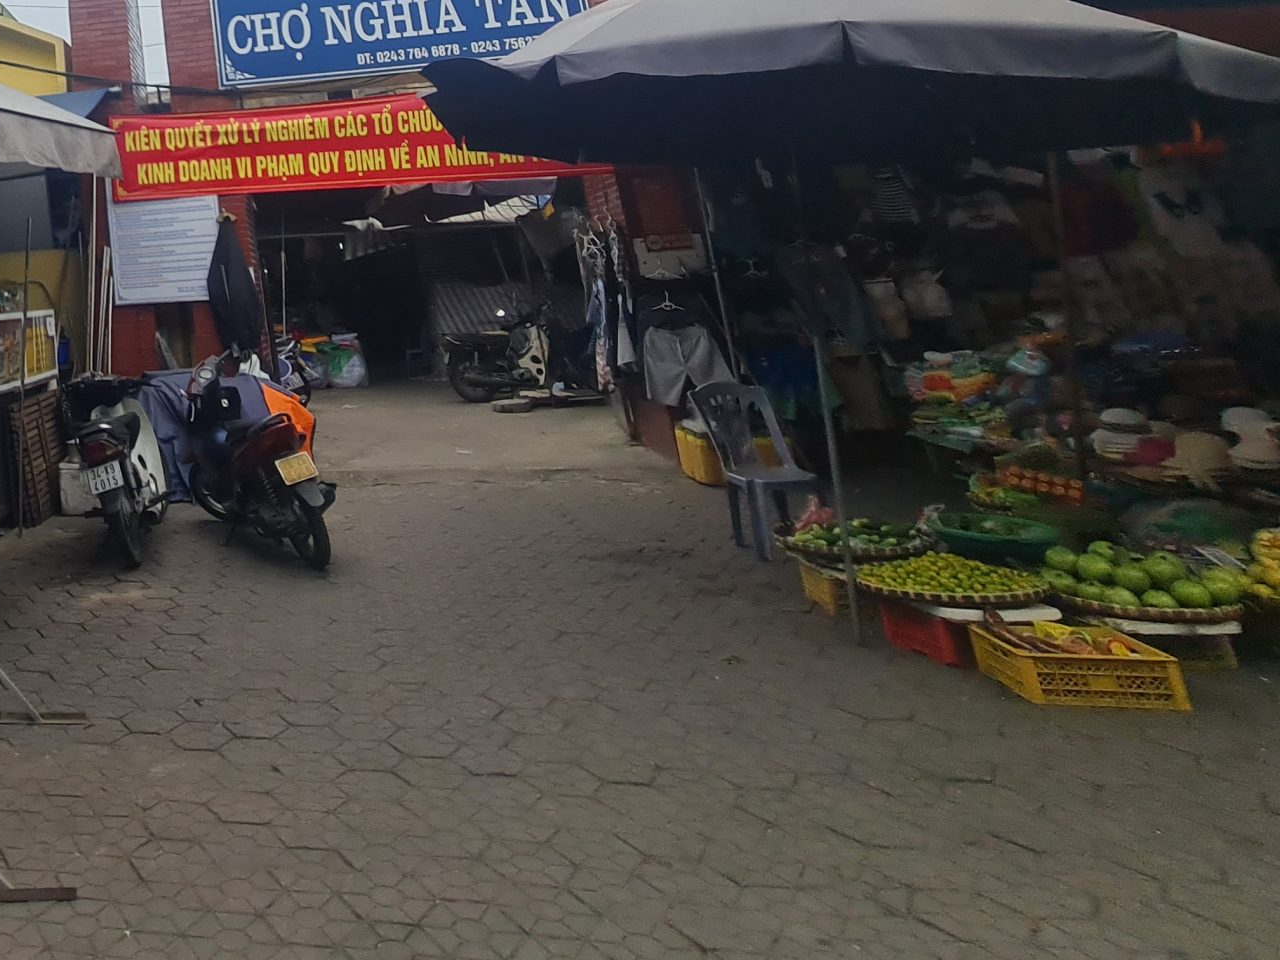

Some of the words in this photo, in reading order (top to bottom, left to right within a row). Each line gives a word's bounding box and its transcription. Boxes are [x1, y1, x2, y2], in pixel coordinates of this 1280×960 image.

[227, 3, 311, 61] CHỢ
[377, 48, 406, 64] 0243
[407, 45, 429, 60] 764
[431, 43, 460, 57] 6878
[471, 40, 501, 54] 0243
[504, 35, 539, 50] 7562
[124, 125, 161, 152] KIÊN
[165, 119, 212, 151] QUYẾT
[217, 117, 239, 146] XỬ
[242, 118, 261, 144] LÝ
[265, 113, 330, 142] NGHIÊM
[334, 110, 368, 138] CÁC
[371, 103, 393, 135] TỔ
[137, 160, 176, 185] KINH
[179, 157, 234, 183] DOANH
[235, 156, 252, 179] VI
[256, 153, 305, 181] PHẠM
[308, 150, 339, 177] QUY
[344, 146, 386, 176] ĐỊNH
[389, 139, 412, 170] VỀ
[416, 145, 441, 169] AN
